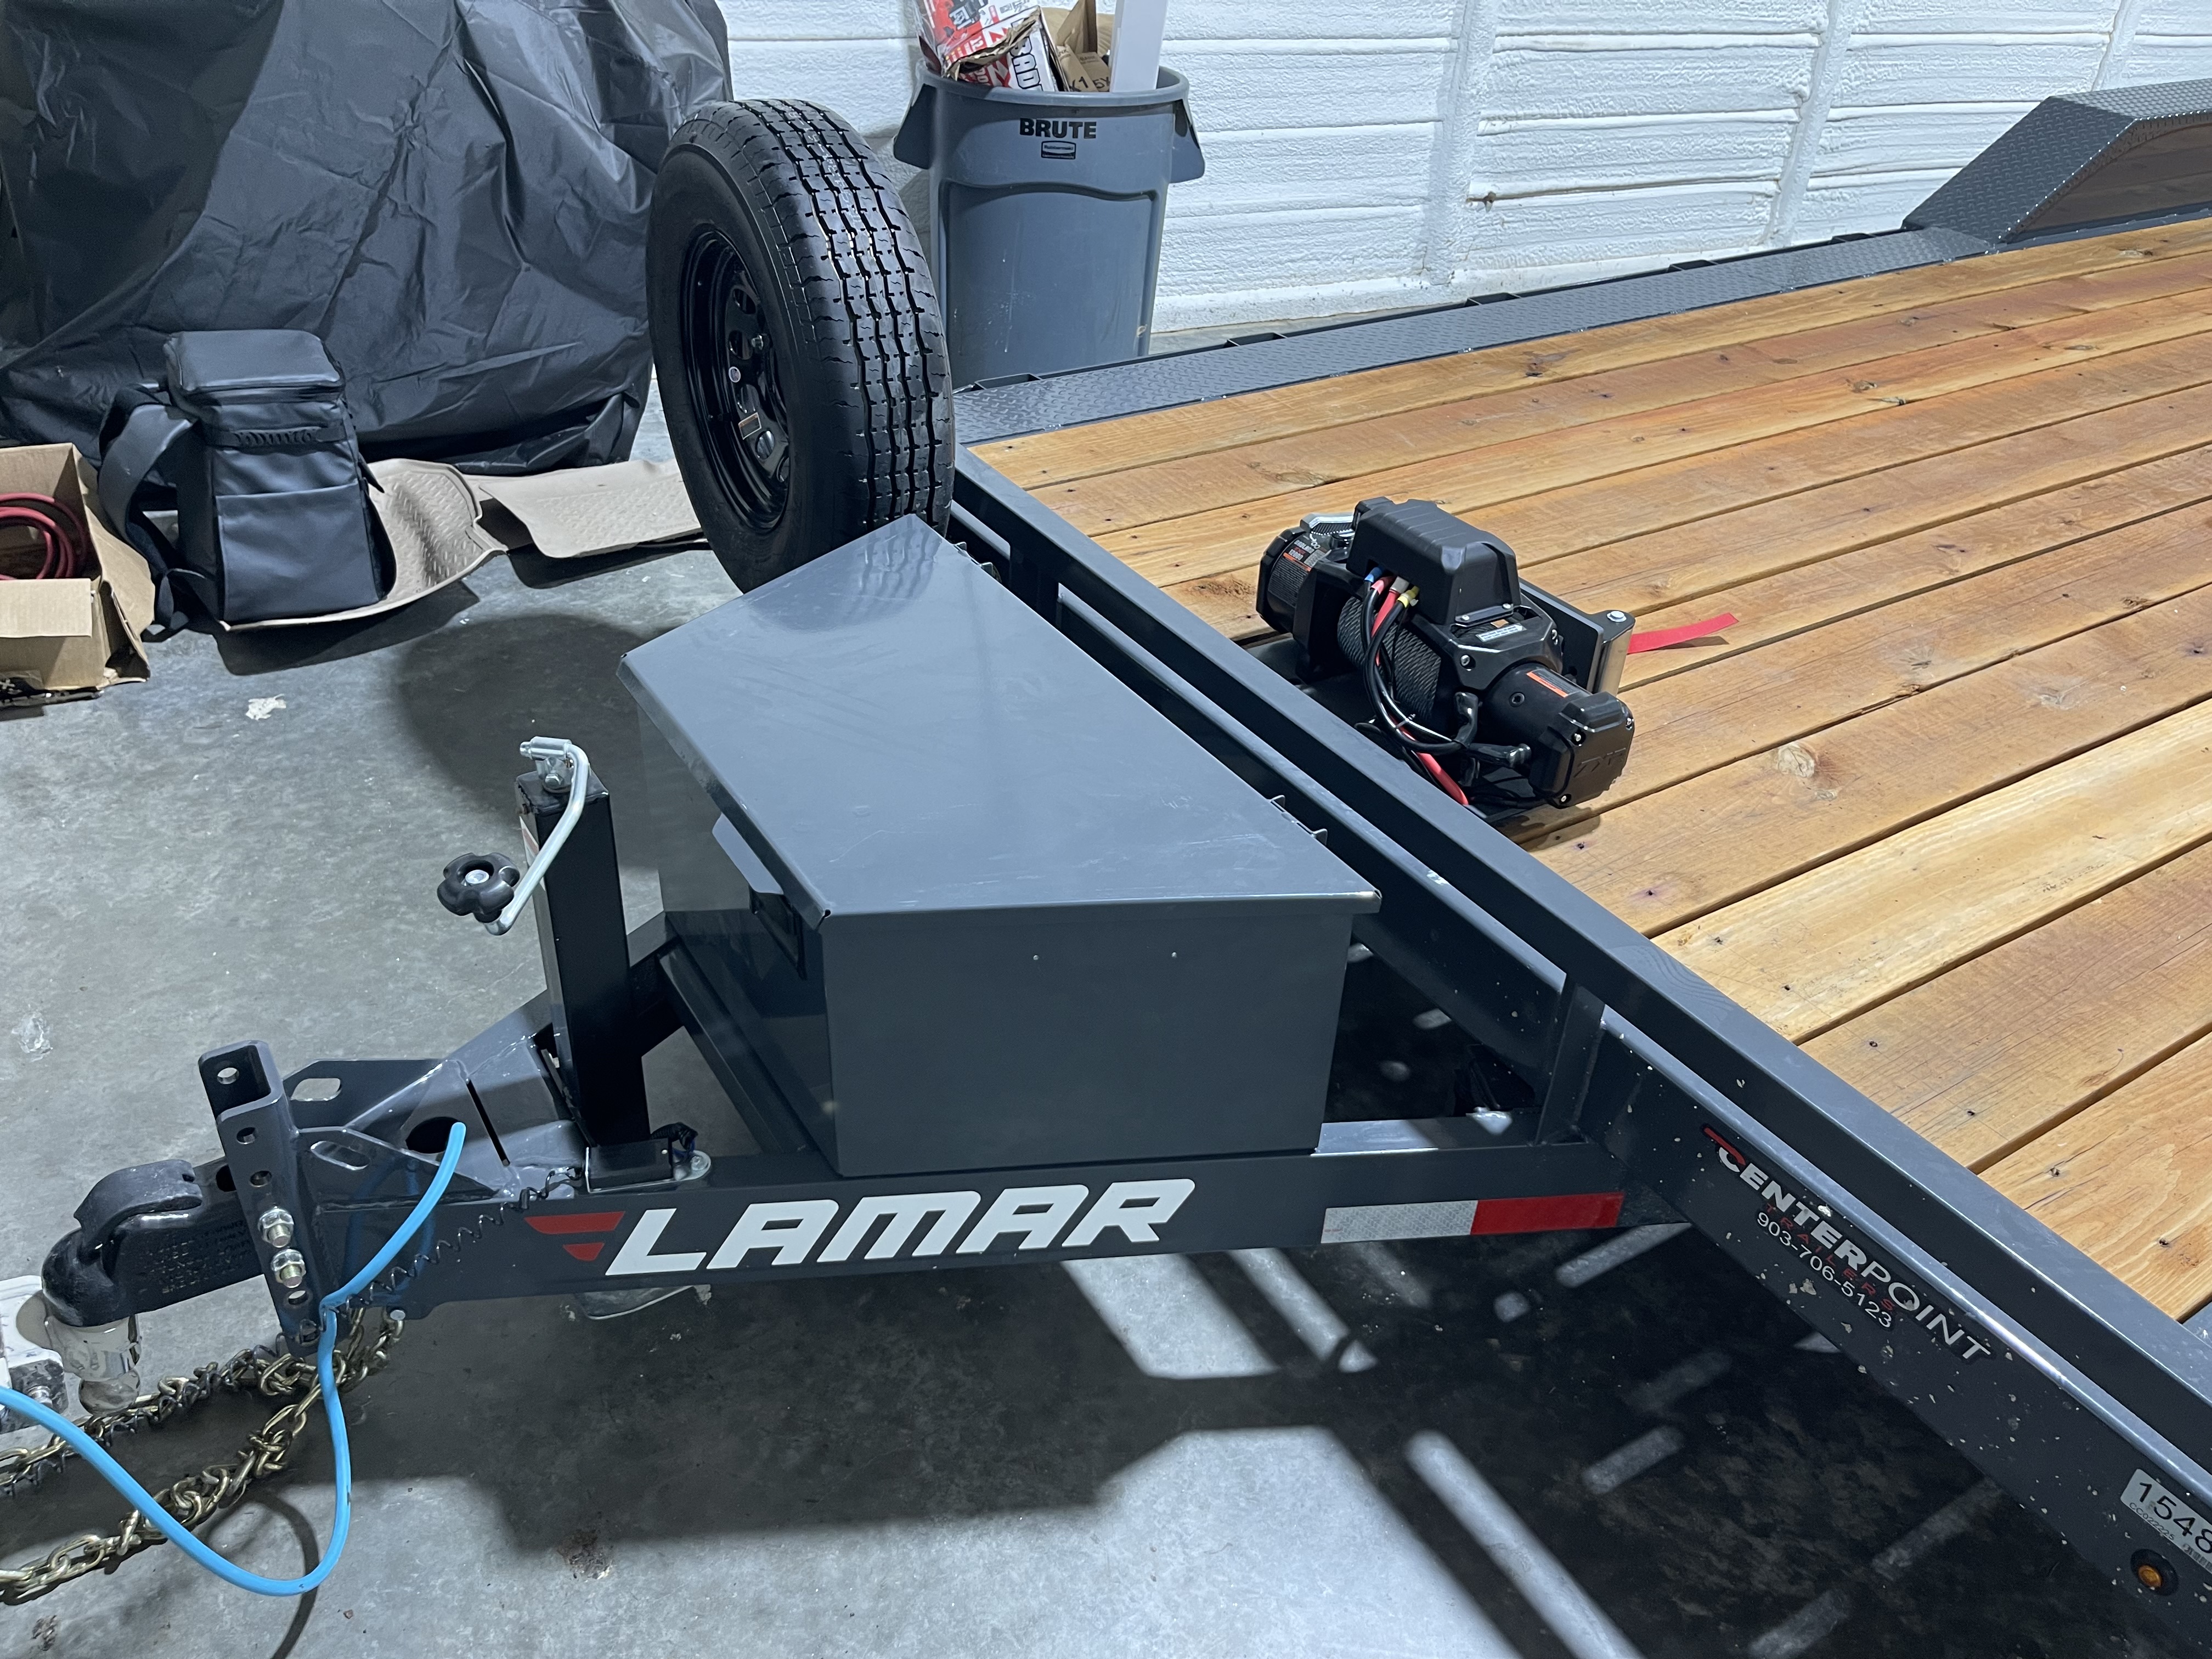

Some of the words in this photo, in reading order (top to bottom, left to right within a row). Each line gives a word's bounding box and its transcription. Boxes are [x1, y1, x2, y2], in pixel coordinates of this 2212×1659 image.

[1020, 118, 1097, 139] BRUTE
[1288, 549, 1304, 561] 12000
[605, 1178, 1196, 1277] LAMAR
[1703, 1125, 1992, 1360] CENTERPOINT
[1756, 1211, 1892, 1328] 903-706-5123
[1766, 1204, 1895, 1311] TRAILERS
